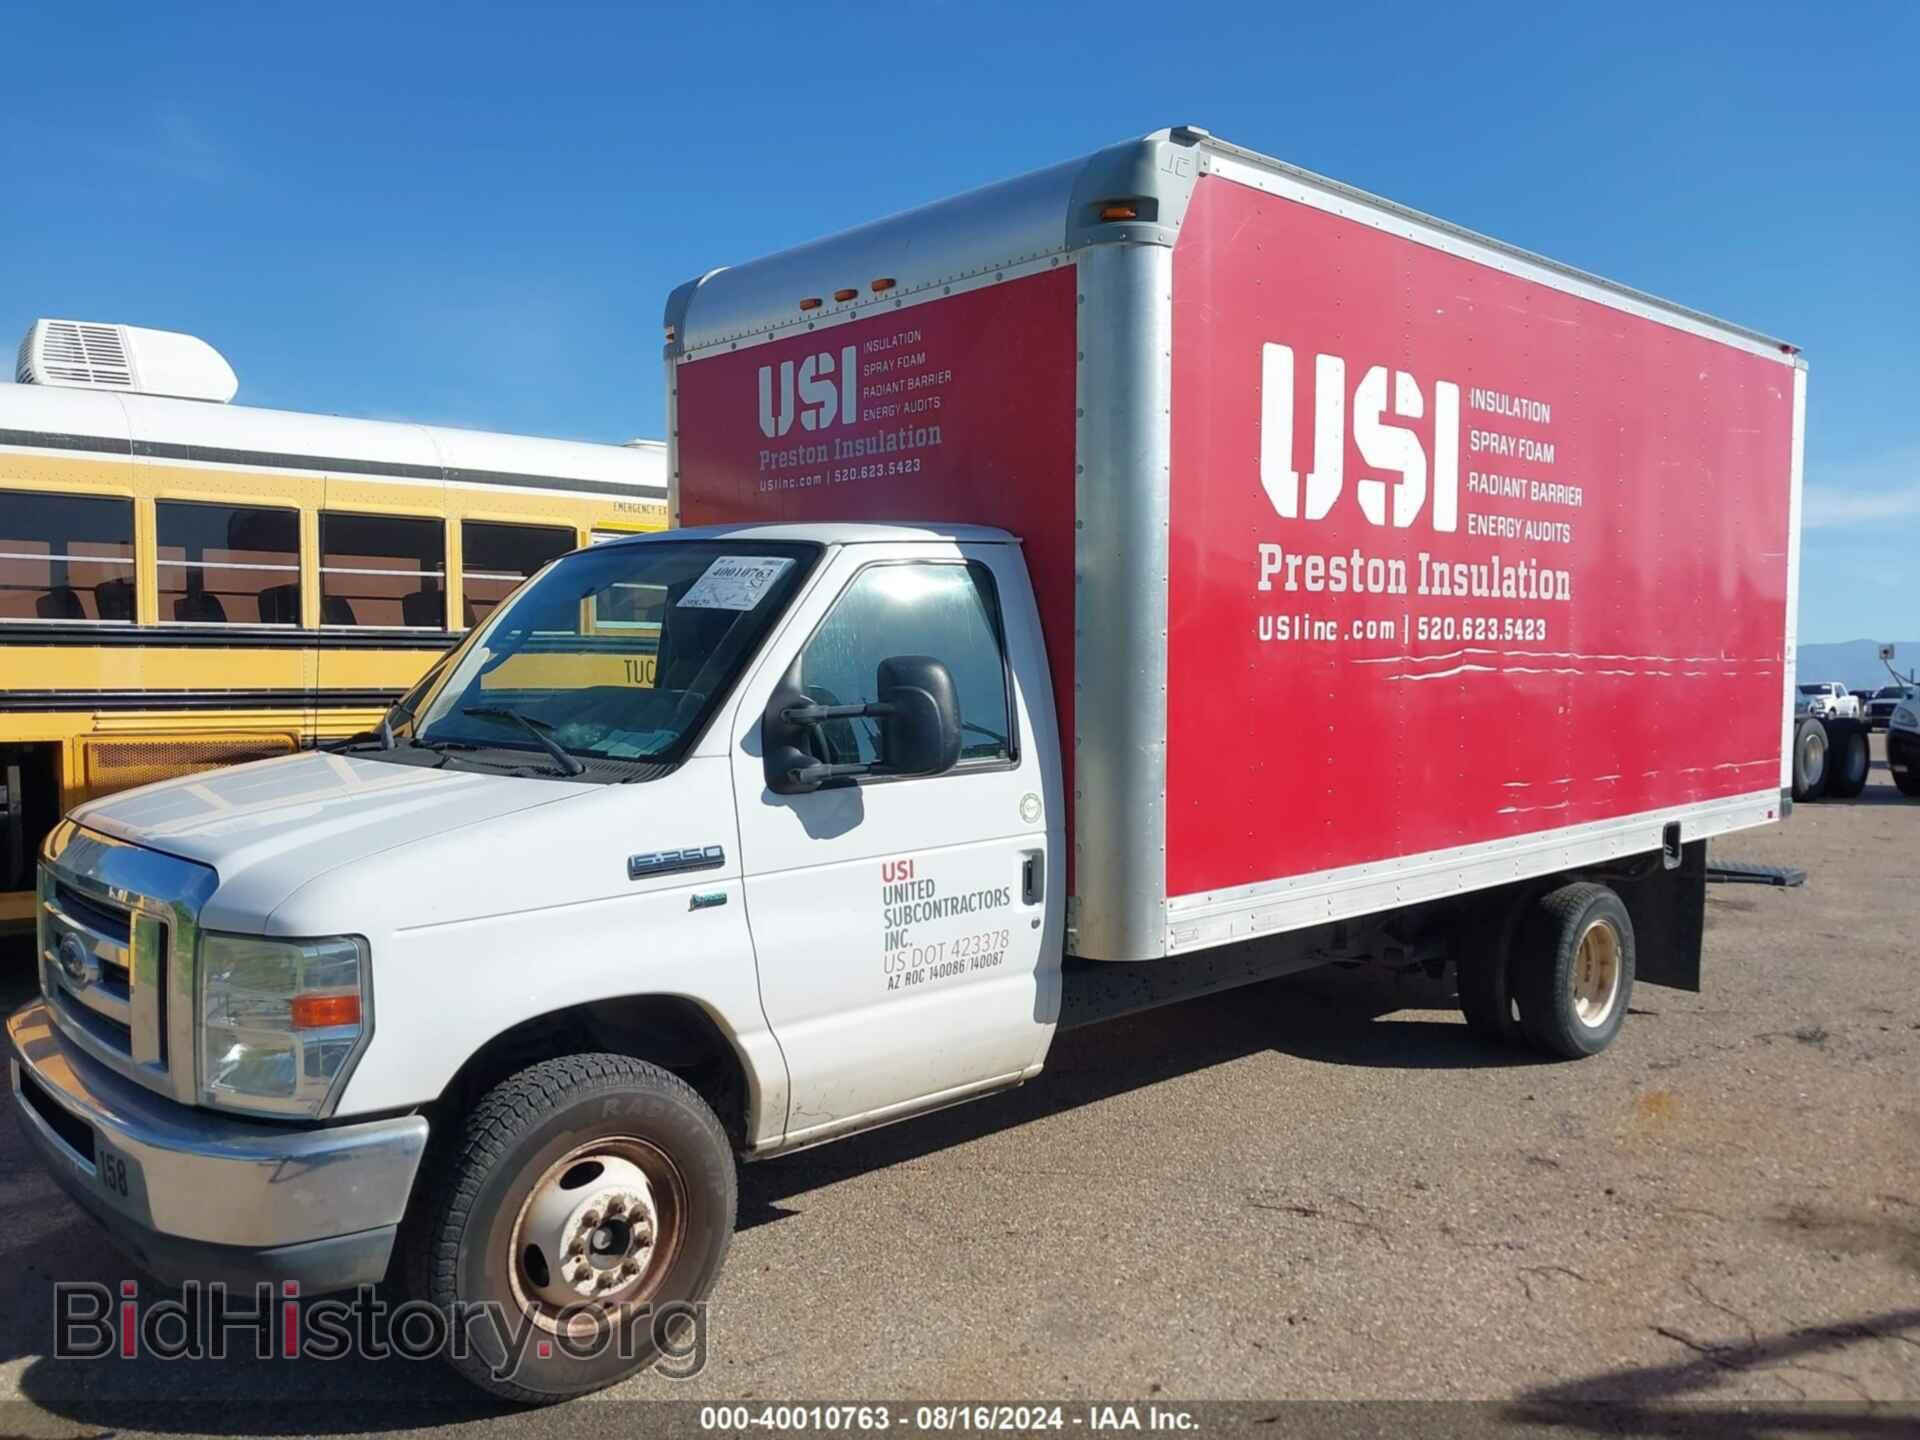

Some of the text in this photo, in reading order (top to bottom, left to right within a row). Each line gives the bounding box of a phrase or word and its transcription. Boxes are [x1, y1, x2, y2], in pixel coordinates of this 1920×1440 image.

[863, 330, 922, 353] INSULATION
[863, 352, 926, 377] SPRAY FOAM
[758, 346, 857, 438] USI
[863, 370, 952, 399] RADIANT BARRIER
[863, 396, 941, 421] ENERGY AUDITS
[1470, 387, 1551, 424] INSULATION
[759, 424, 942, 472] Preston Insulation
[1260, 341, 1460, 533] USI
[1470, 430, 1555, 463] SPRAY FOAM
[834, 458, 921, 482] 520.623.5423
[1469, 471, 1584, 507] RADIANT BARRIER
[611, 501, 656, 514] EMERGENCY
[1467, 513, 1571, 543] ENERGY AUDITS
[1257, 543, 1571, 601] Preston Insulation
[1417, 615, 1546, 641] 520.623.5423
[882, 859, 914, 883] USI
[883, 878, 935, 906] UNITED
[884, 886, 1010, 930] SUBCONTRACTORS
[883, 929, 1009, 975] US DOT 423378
[884, 928, 913, 952] INC.
[887, 975, 901, 991] AZ
[904, 969, 925, 986] ROC
